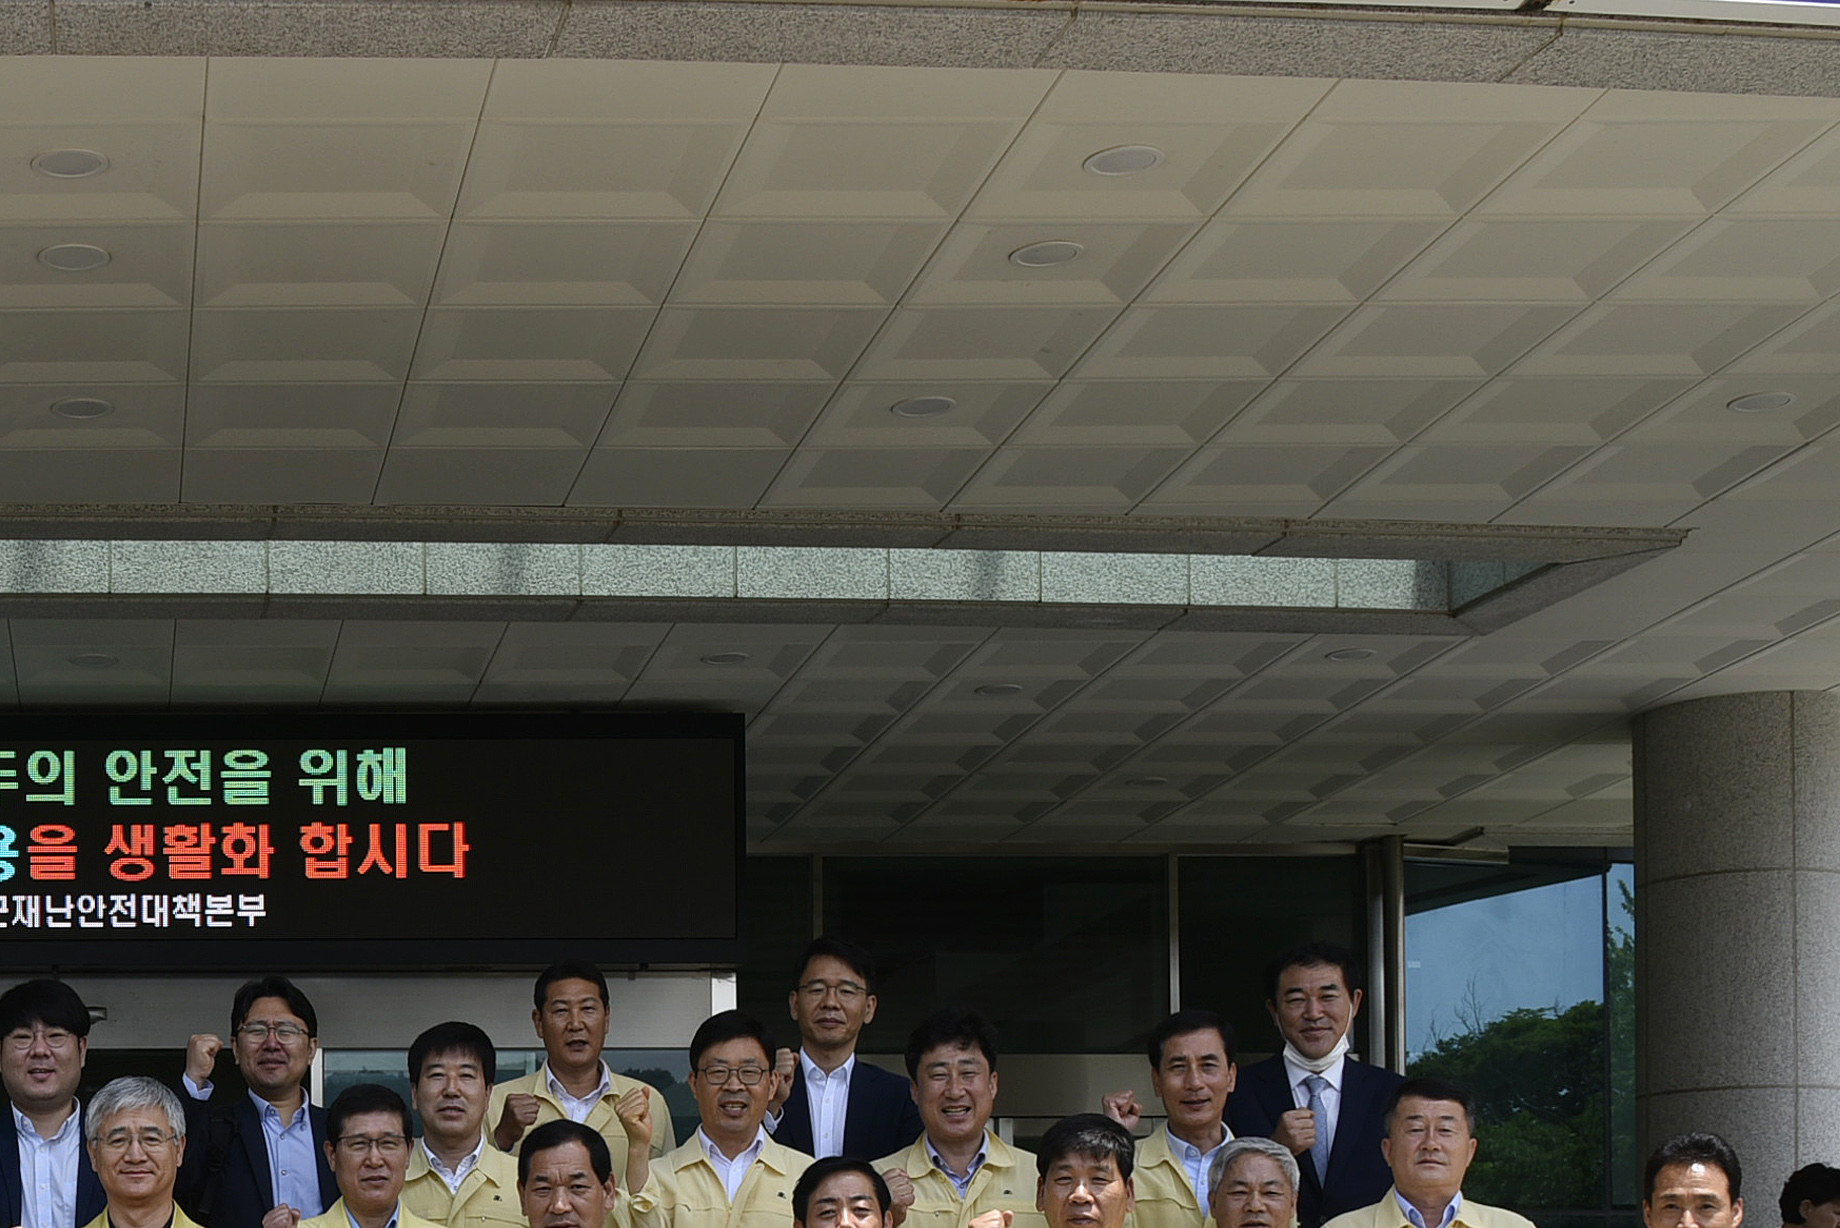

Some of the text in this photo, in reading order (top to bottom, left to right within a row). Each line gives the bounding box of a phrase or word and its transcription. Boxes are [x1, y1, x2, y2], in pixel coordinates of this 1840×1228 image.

[105, 749, 272, 806] 안전을
[298, 747, 407, 807] 위해
[104, 821, 276, 882] 생활화
[299, 821, 472, 879] 합시다
